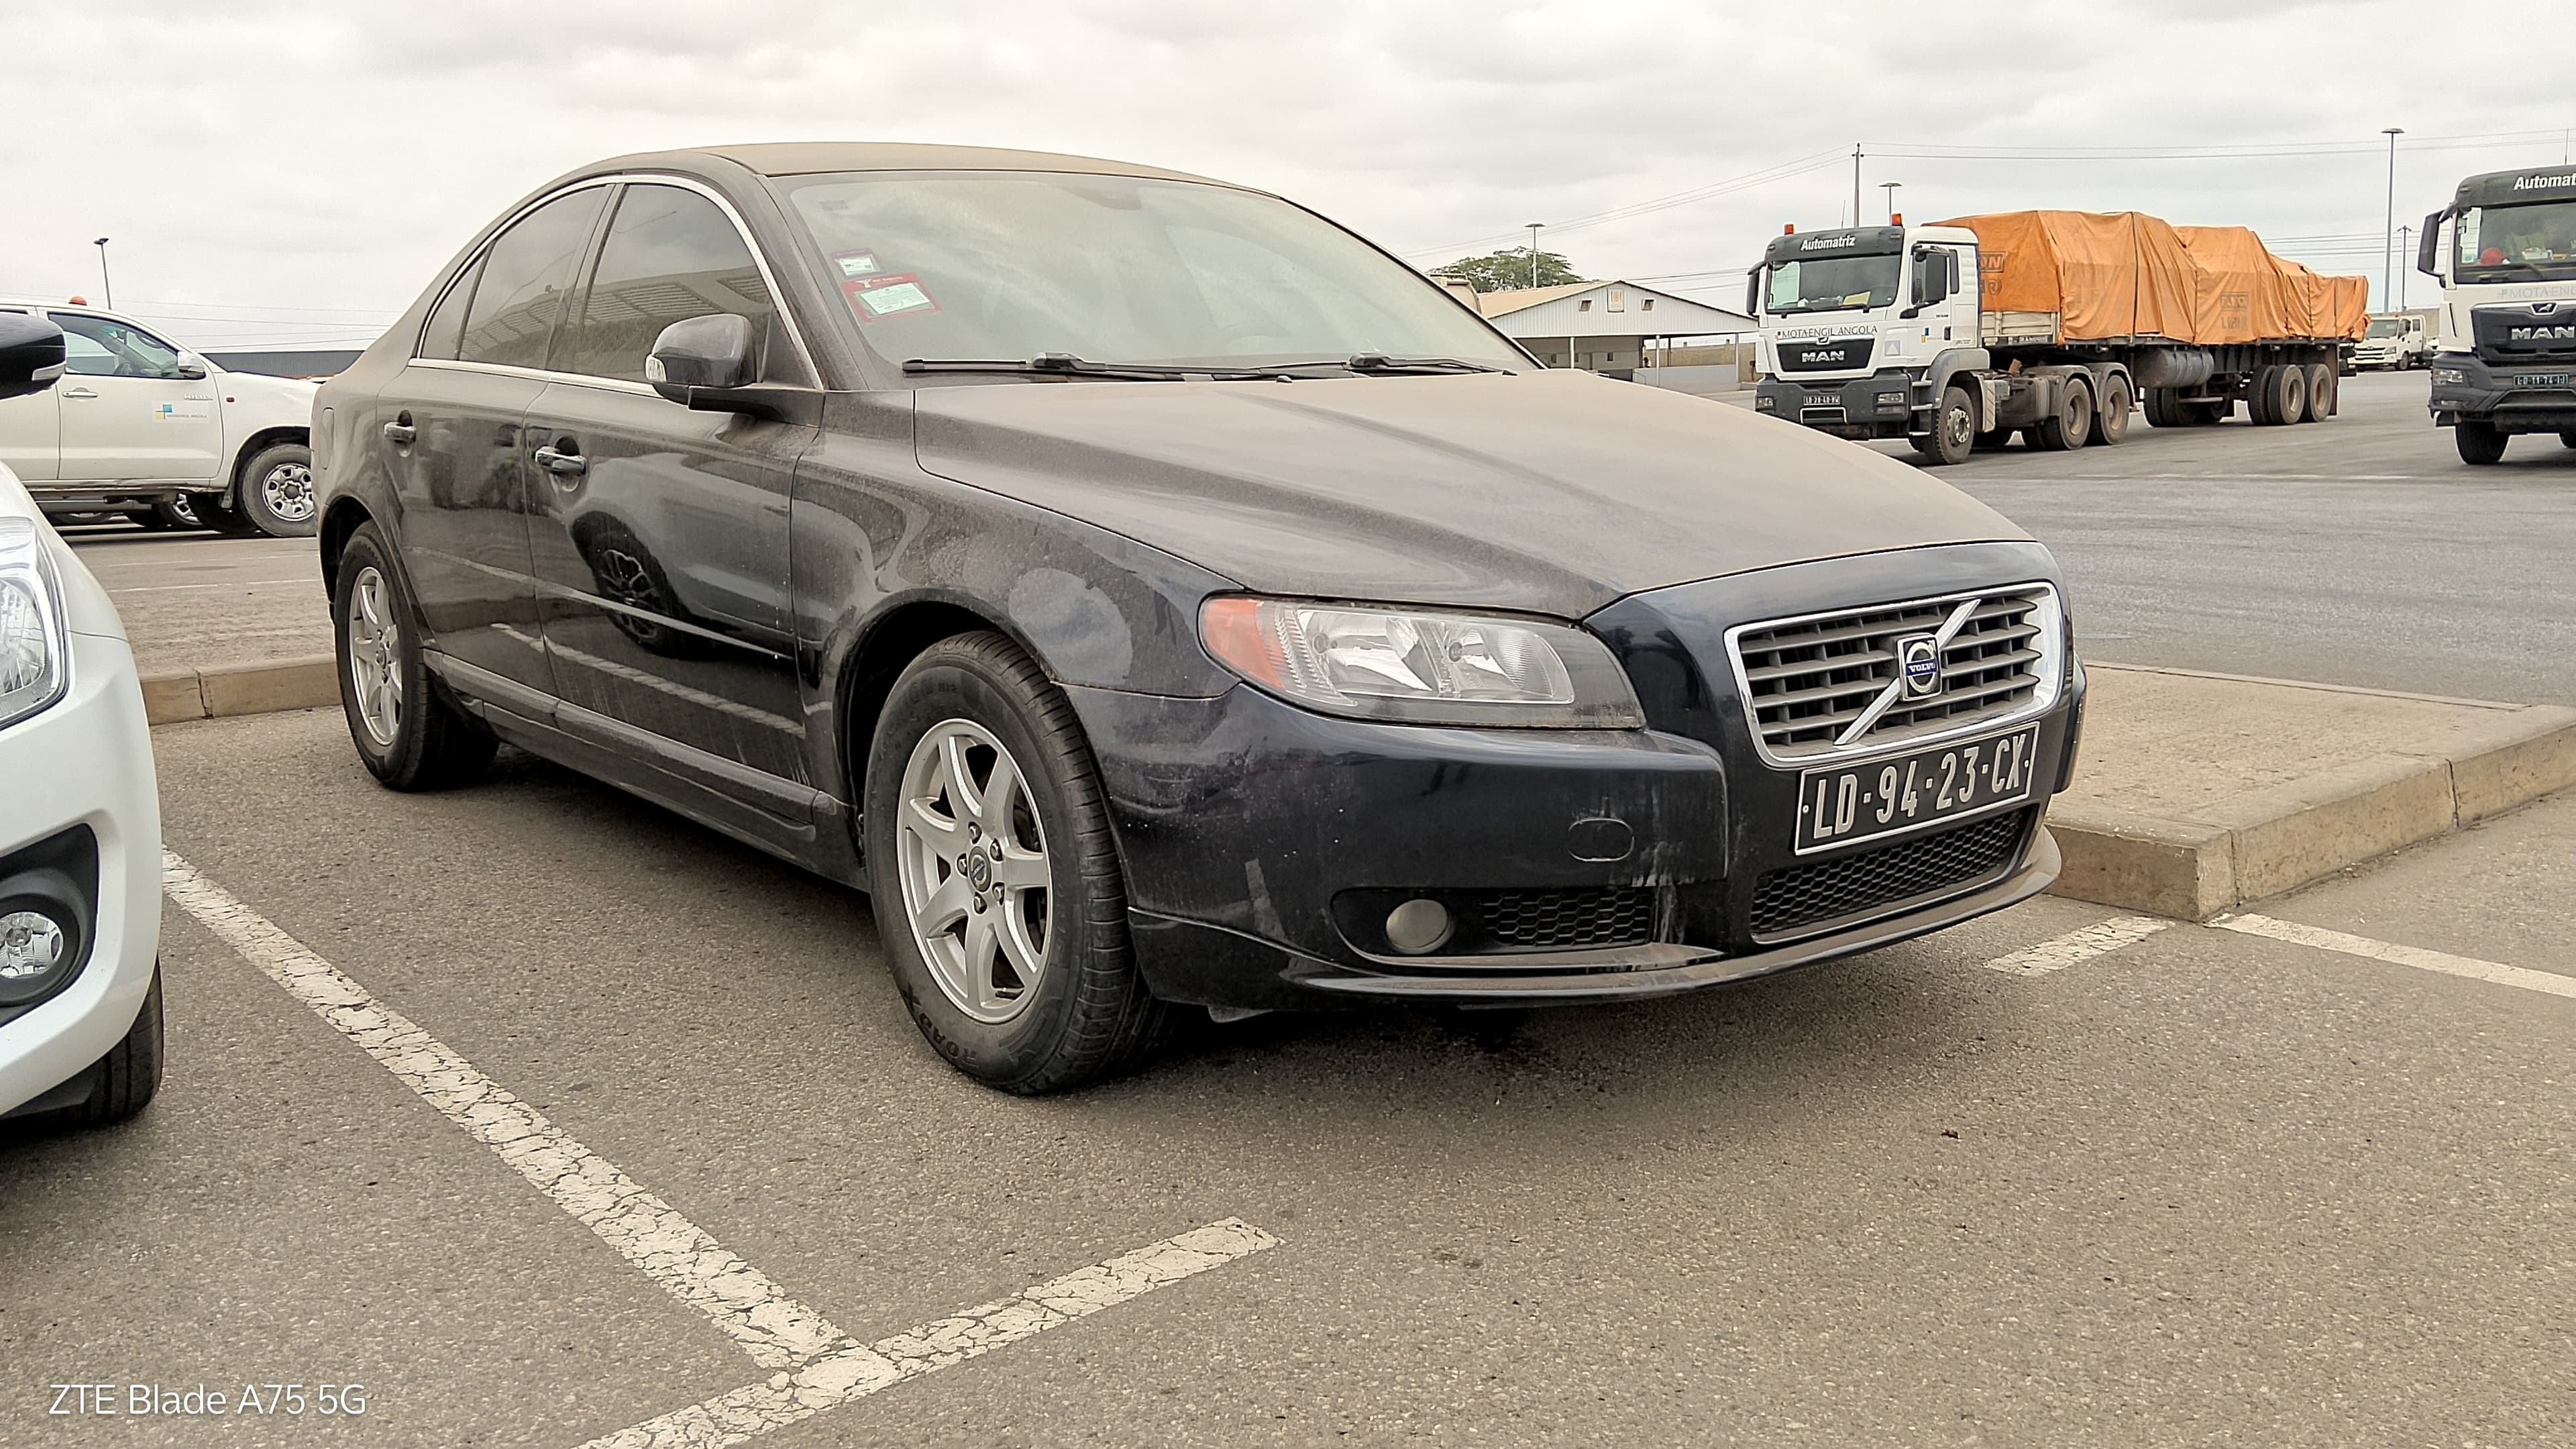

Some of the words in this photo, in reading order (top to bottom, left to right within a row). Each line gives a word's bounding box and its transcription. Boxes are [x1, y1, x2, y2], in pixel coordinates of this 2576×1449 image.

[2514, 173, 2576, 190] Automat
[1801, 235, 1856, 251] Automatriz
[1837, 325, 1878, 335] ANGOLA
[2512, 326, 2575, 340] MAN
[1801, 351, 1845, 362] MAN
[1908, 663, 1936, 672] VOLVO
